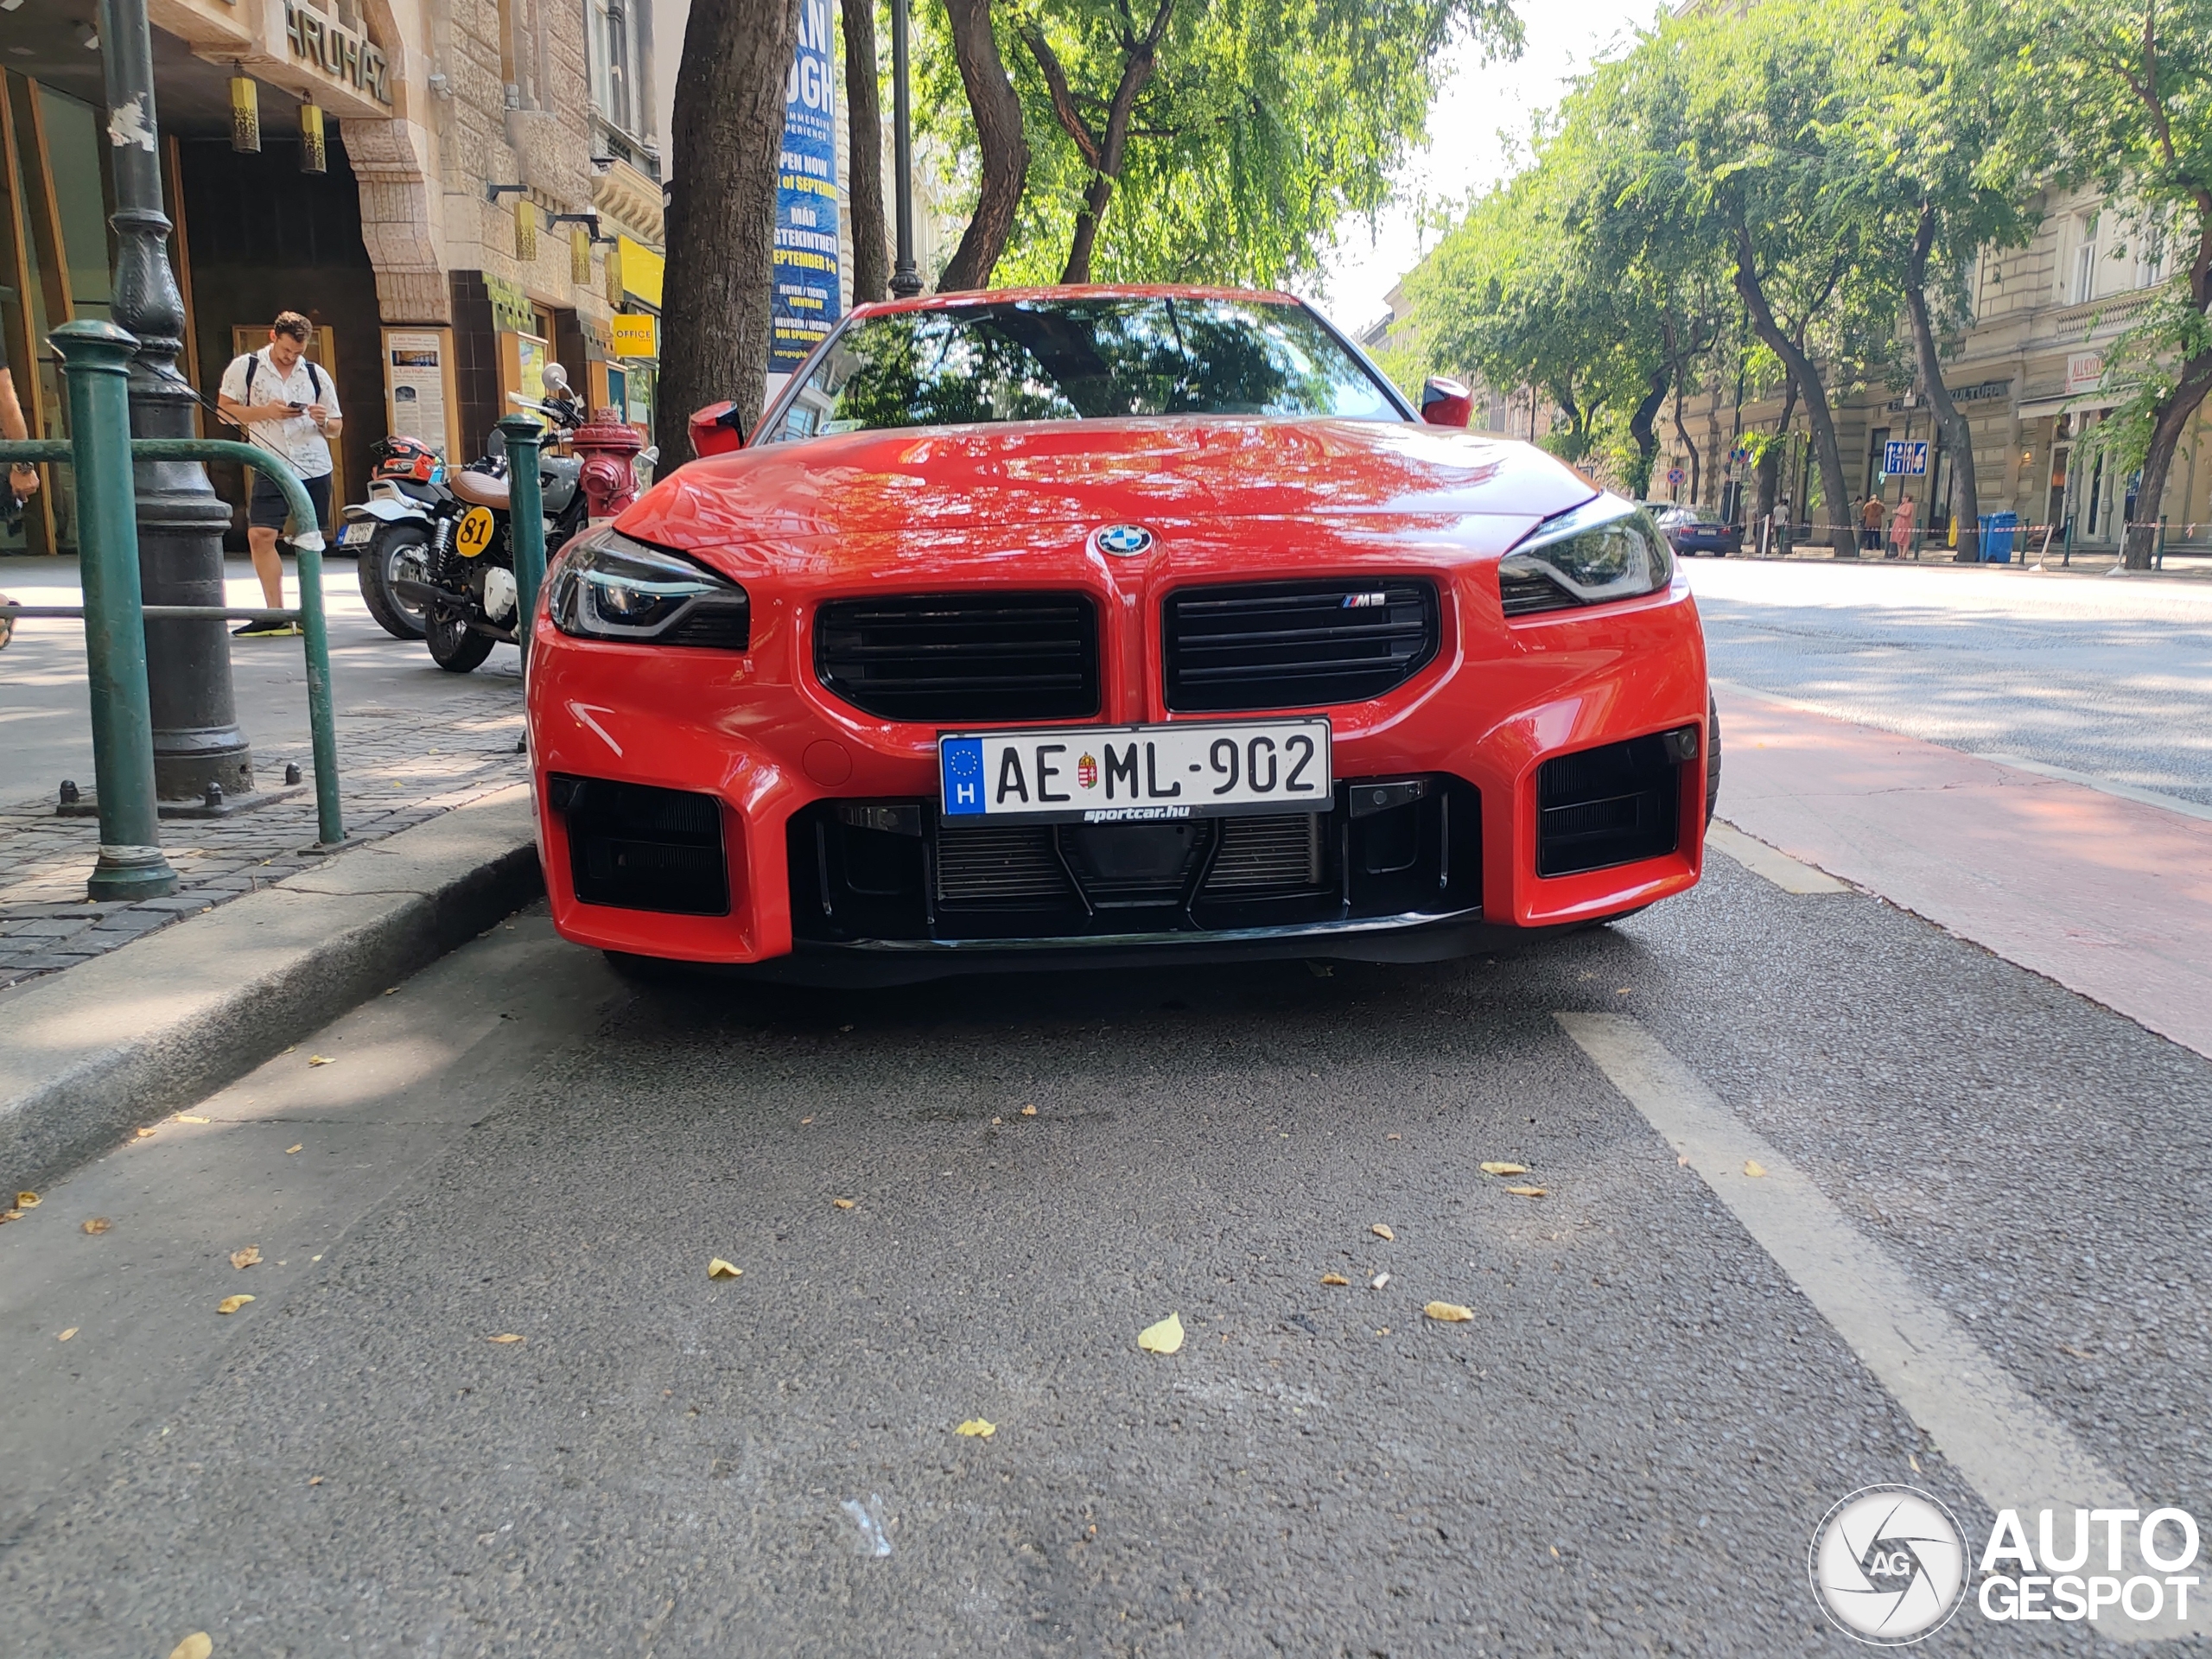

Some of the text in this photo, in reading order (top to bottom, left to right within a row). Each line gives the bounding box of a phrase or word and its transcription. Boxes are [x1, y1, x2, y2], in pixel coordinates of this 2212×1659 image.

[785, 123, 827, 143] PERIENCE
[779, 150, 827, 178] PEN NOW
[791, 206, 817, 228] MÁR
[772, 248, 825, 270] EPTEMBER
[616, 330, 651, 339] OFFICE
[461, 518, 487, 546] 81
[996, 744, 1071, 804] AE
[957, 782, 976, 804] H
[1084, 804, 1191, 823] sportcar.hu
